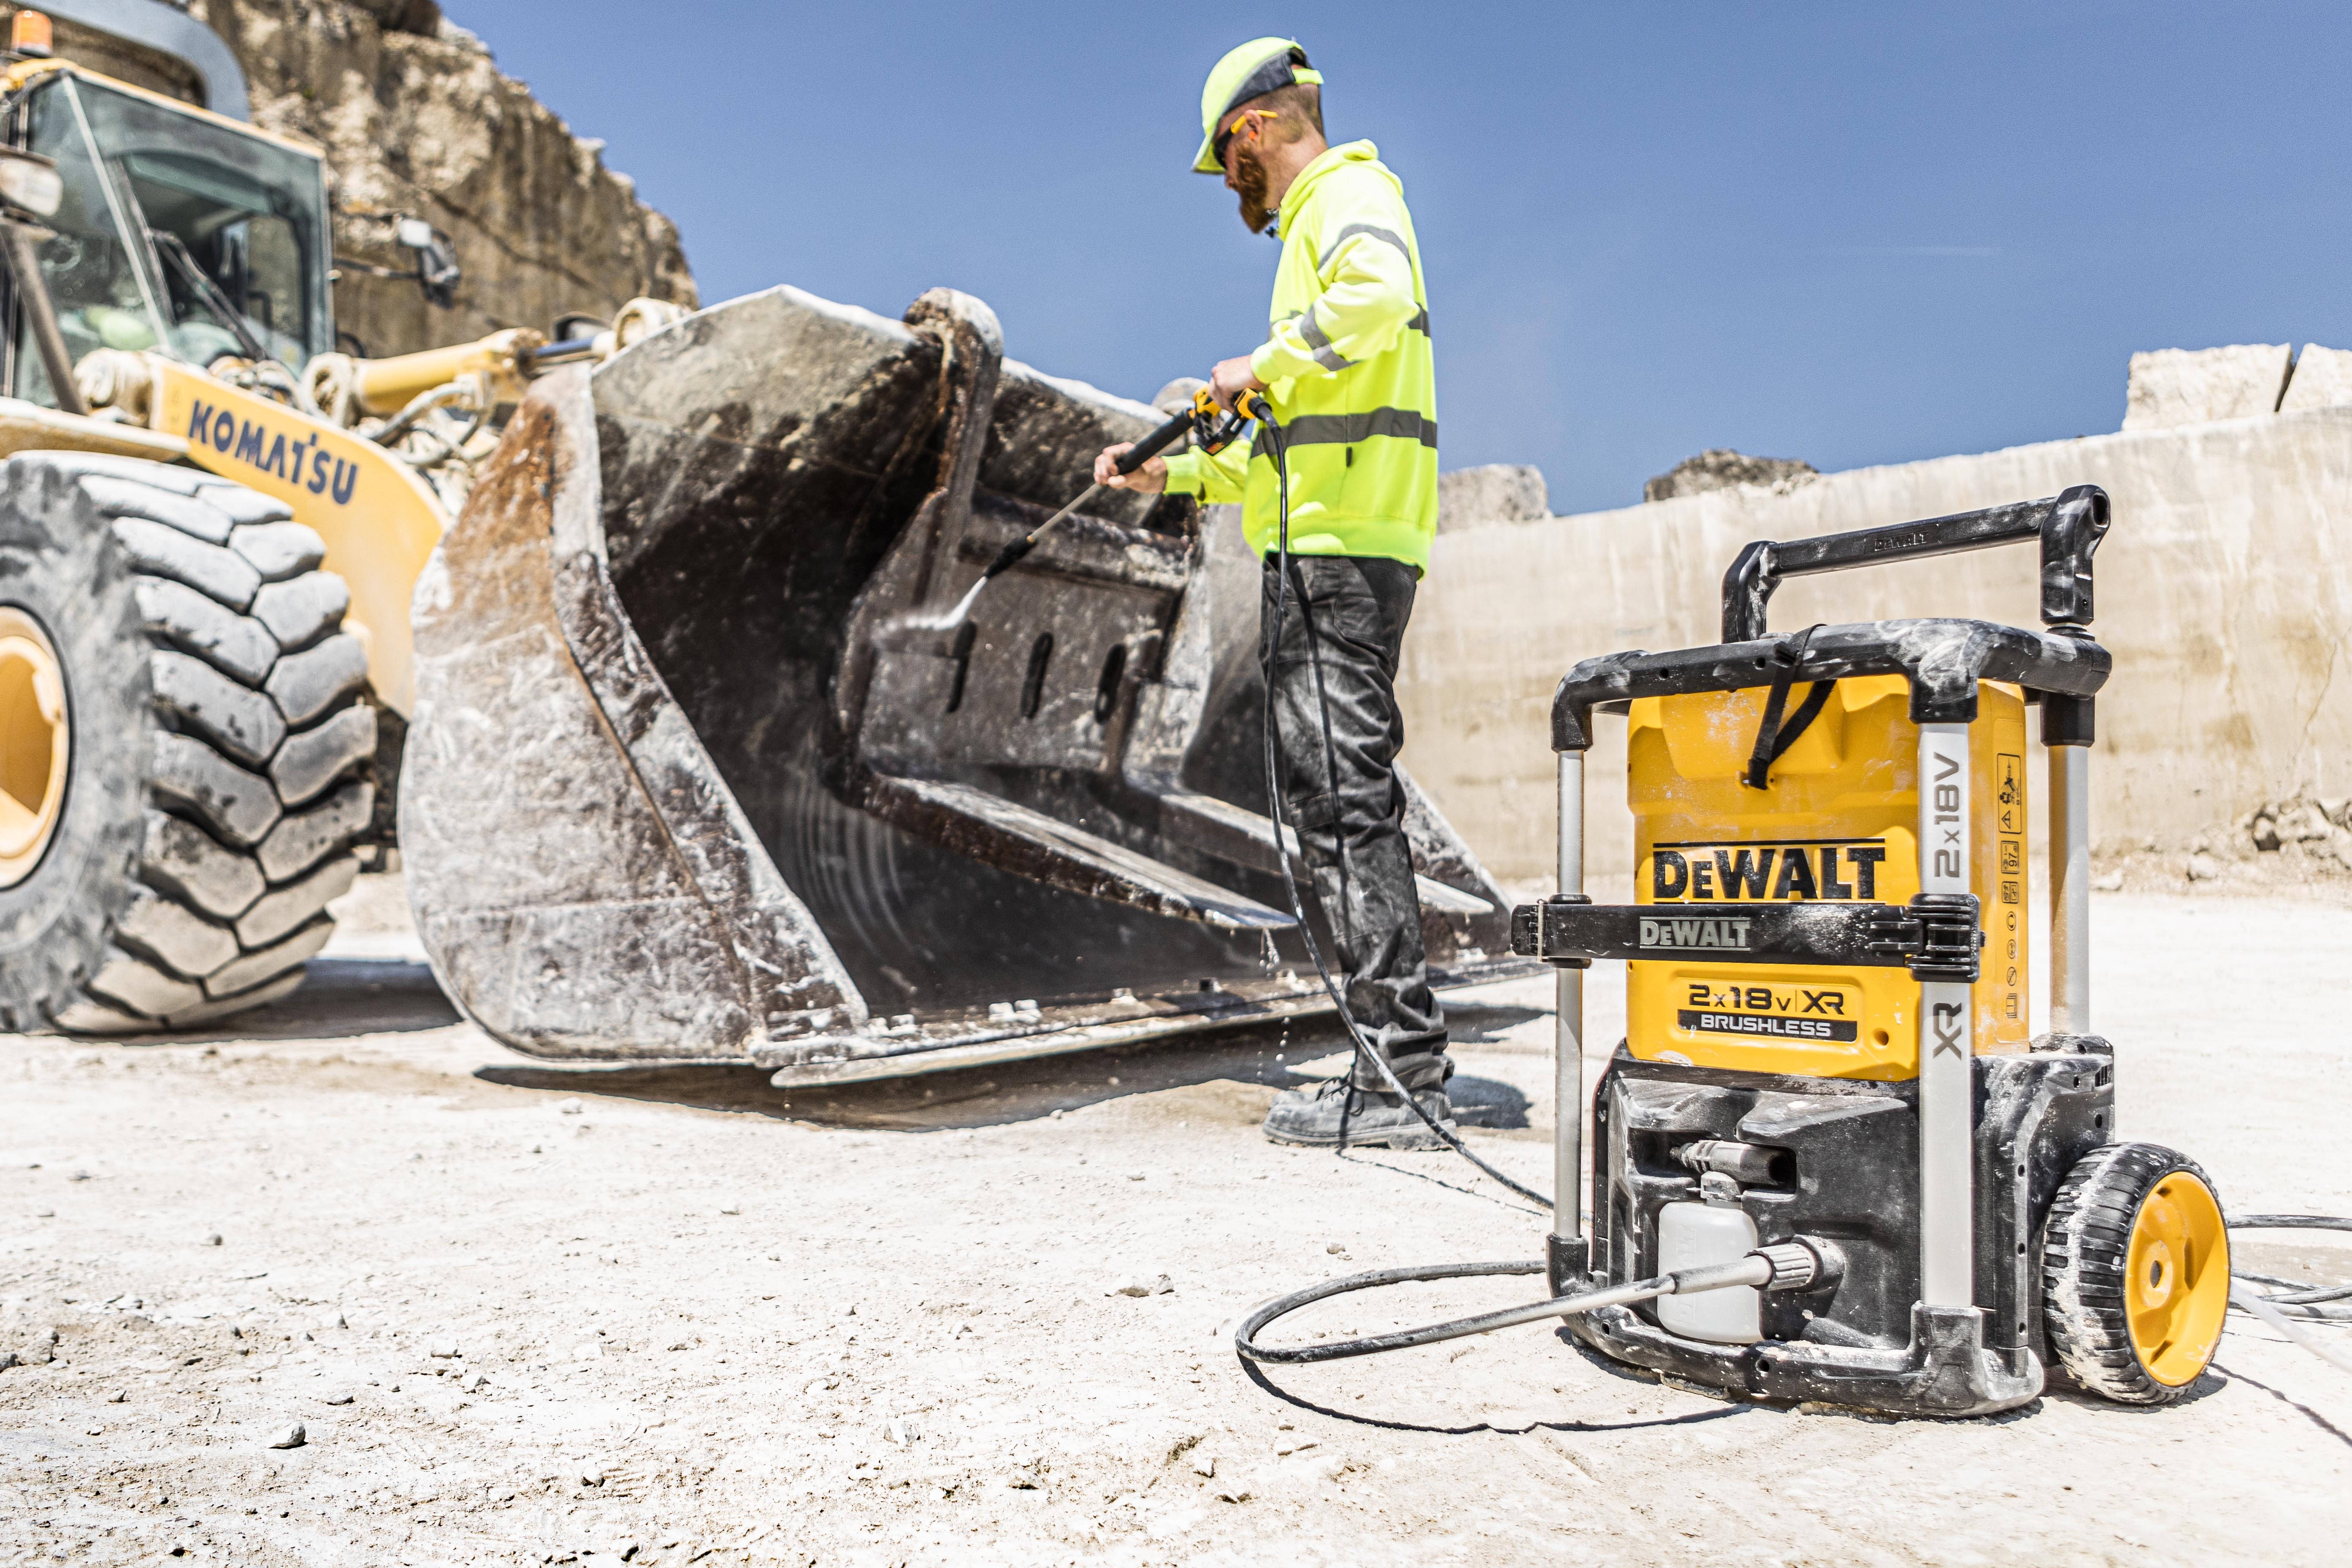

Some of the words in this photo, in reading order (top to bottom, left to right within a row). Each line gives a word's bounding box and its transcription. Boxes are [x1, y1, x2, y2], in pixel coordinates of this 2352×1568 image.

[189, 399, 358, 505] KOMATSU
[1933, 751, 1960, 878] 2x18V
[1653, 847, 1886, 899] DEWALT
[1640, 921, 1751, 947] DEWALT
[1701, 1014, 1831, 1037] BRUSHLESS
[1801, 990, 1845, 1015] XR
[1933, 1002, 1962, 1061] XR
